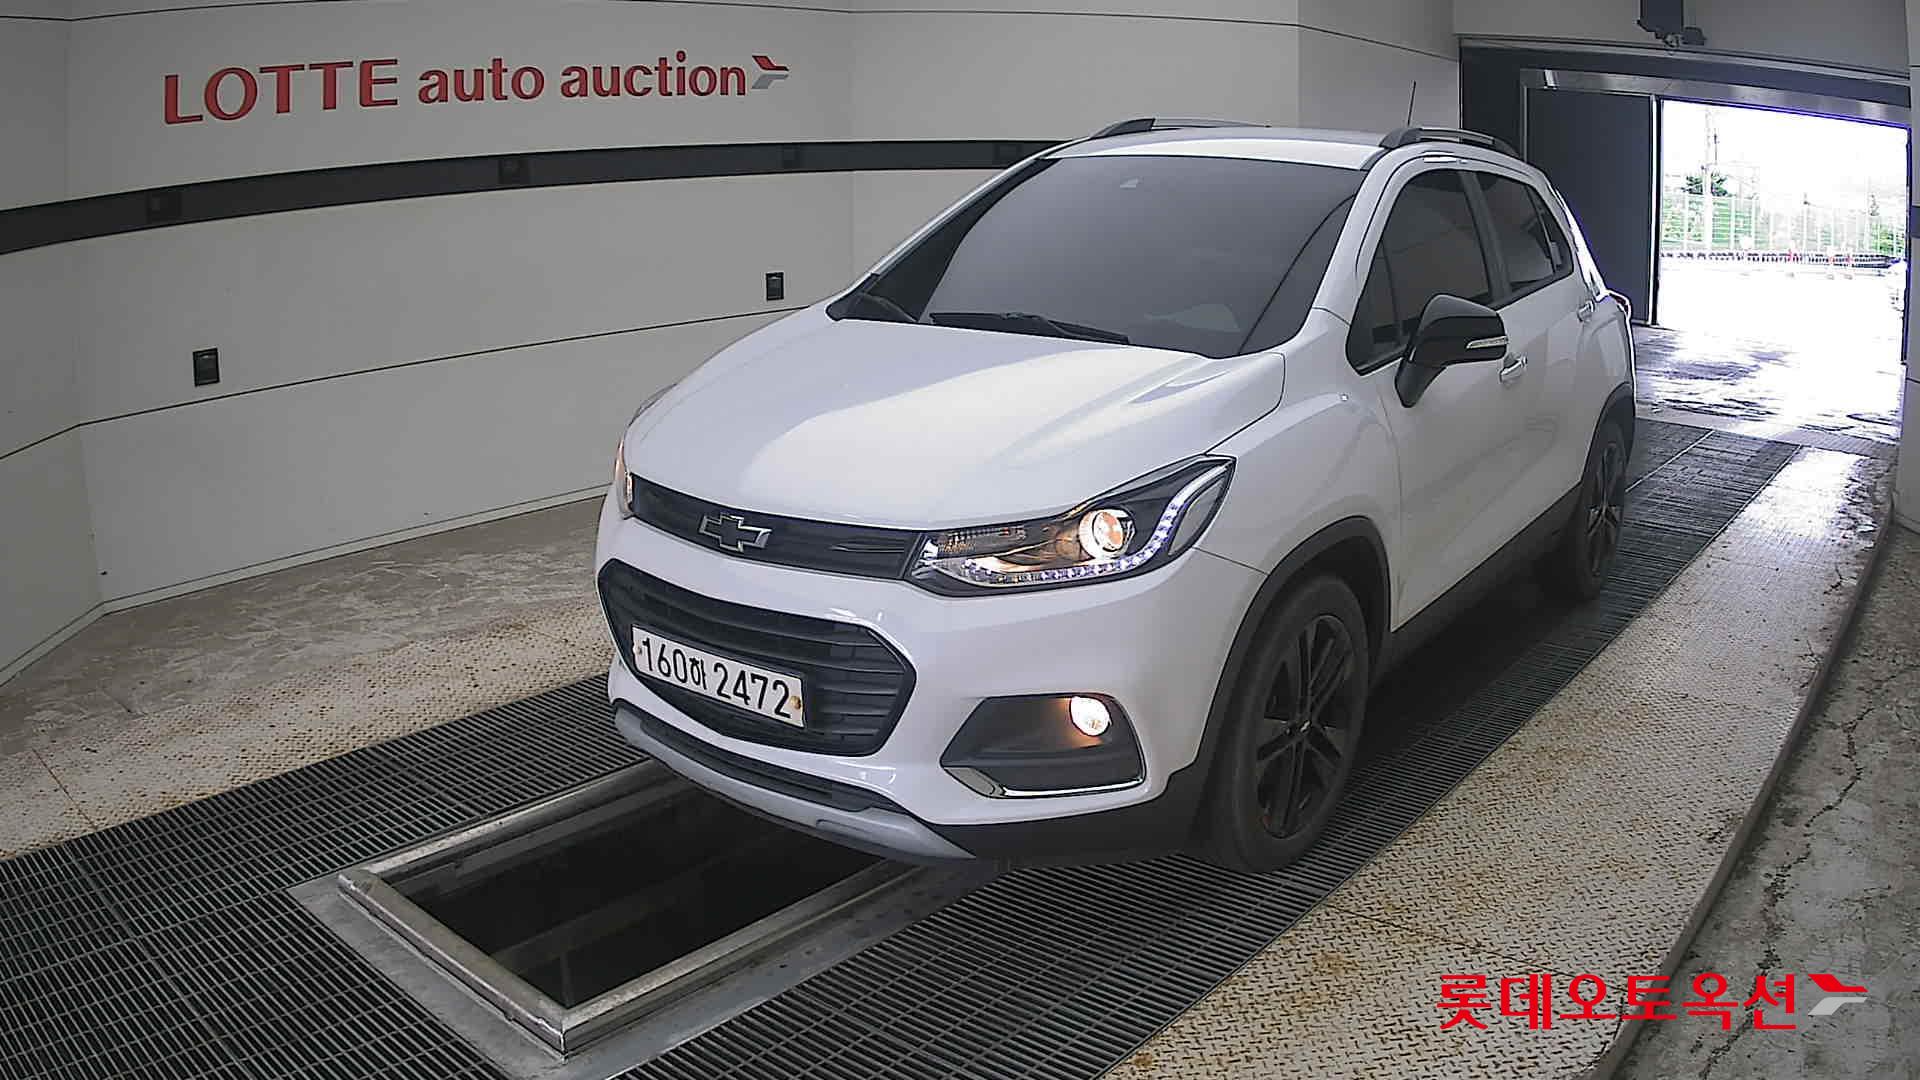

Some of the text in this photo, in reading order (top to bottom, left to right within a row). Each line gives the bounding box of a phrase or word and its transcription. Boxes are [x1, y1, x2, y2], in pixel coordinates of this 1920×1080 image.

[163, 50, 747, 125] LOTTE auto auction
[713, 662, 792, 719] 2472
